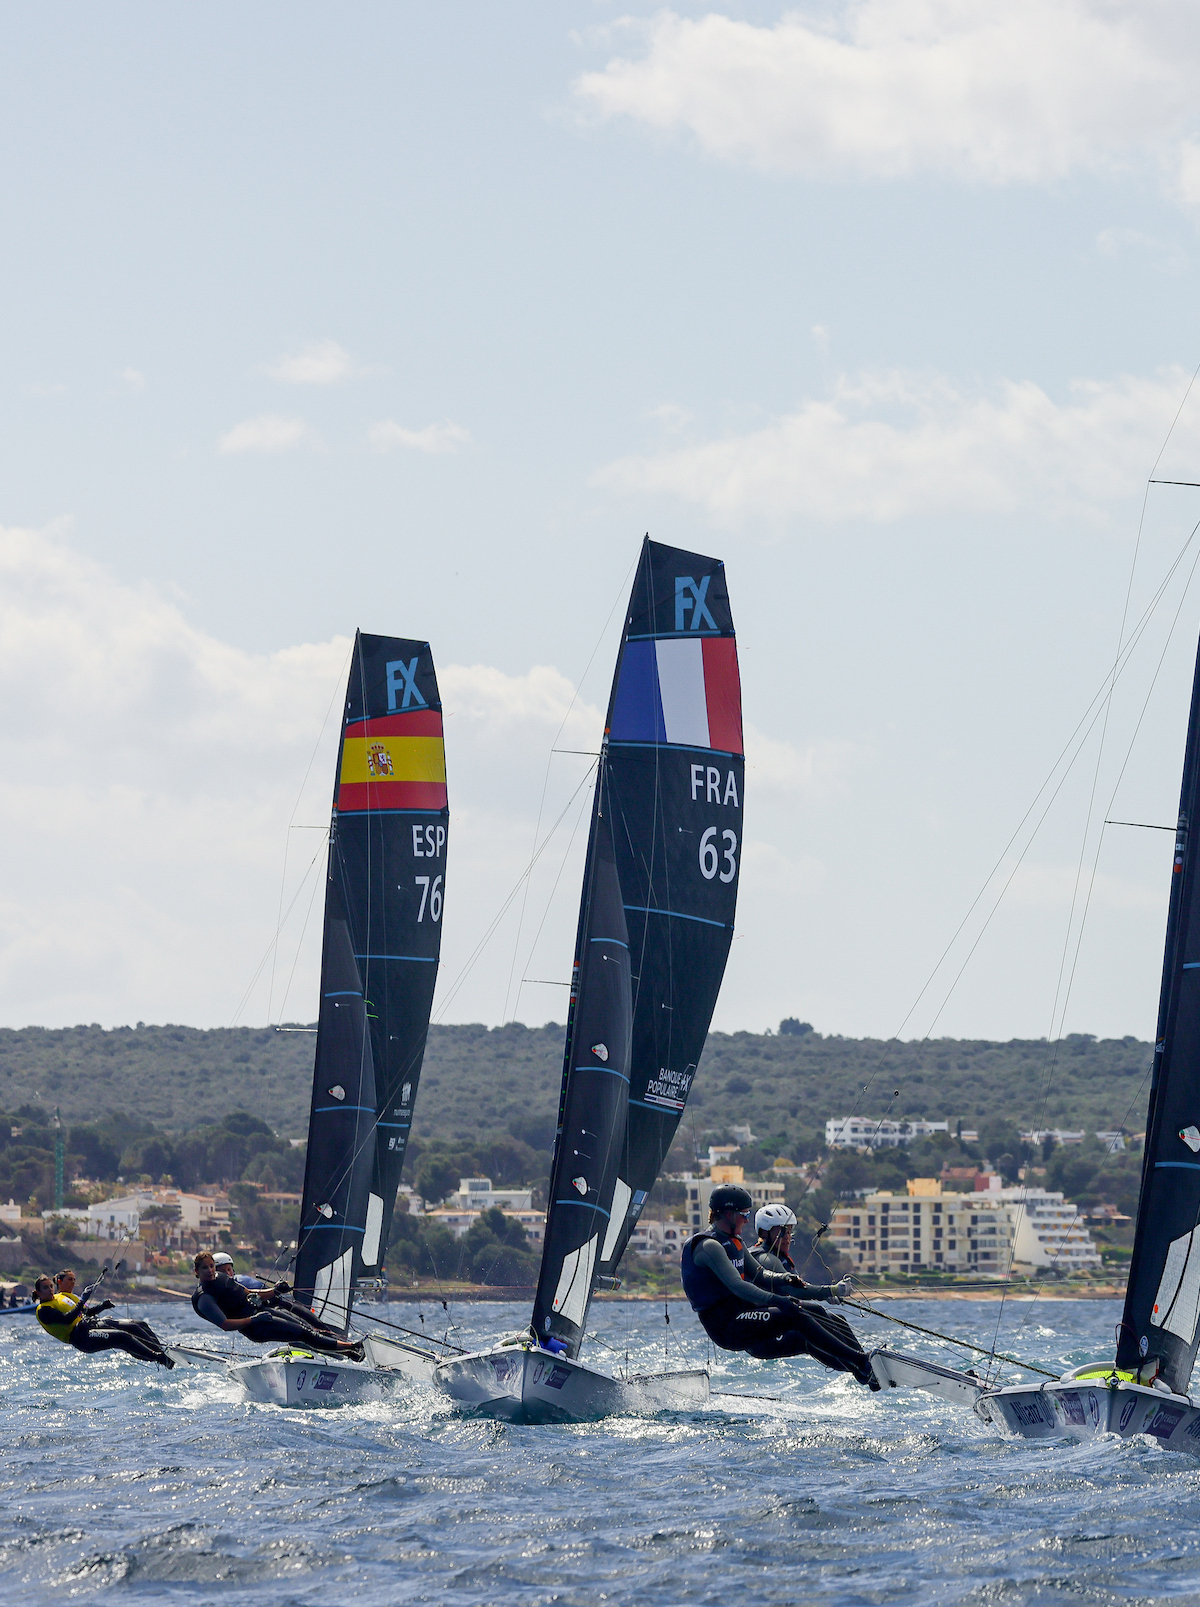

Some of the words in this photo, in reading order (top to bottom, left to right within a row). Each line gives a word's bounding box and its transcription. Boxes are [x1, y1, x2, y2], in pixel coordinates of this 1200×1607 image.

[674, 575, 718, 631] FX
[385, 656, 427, 710] FX
[690, 763, 739, 808] FRA
[412, 824, 446, 858] ESP
[698, 826, 738, 884] 63
[414, 874, 443, 923] 76
[647, 1079, 679, 1098] POPULAIRE
[659, 1067, 683, 1085] BANQUE
[736, 1311, 771, 1321] MUSTO
[1009, 1400, 1045, 1427] Allianz
